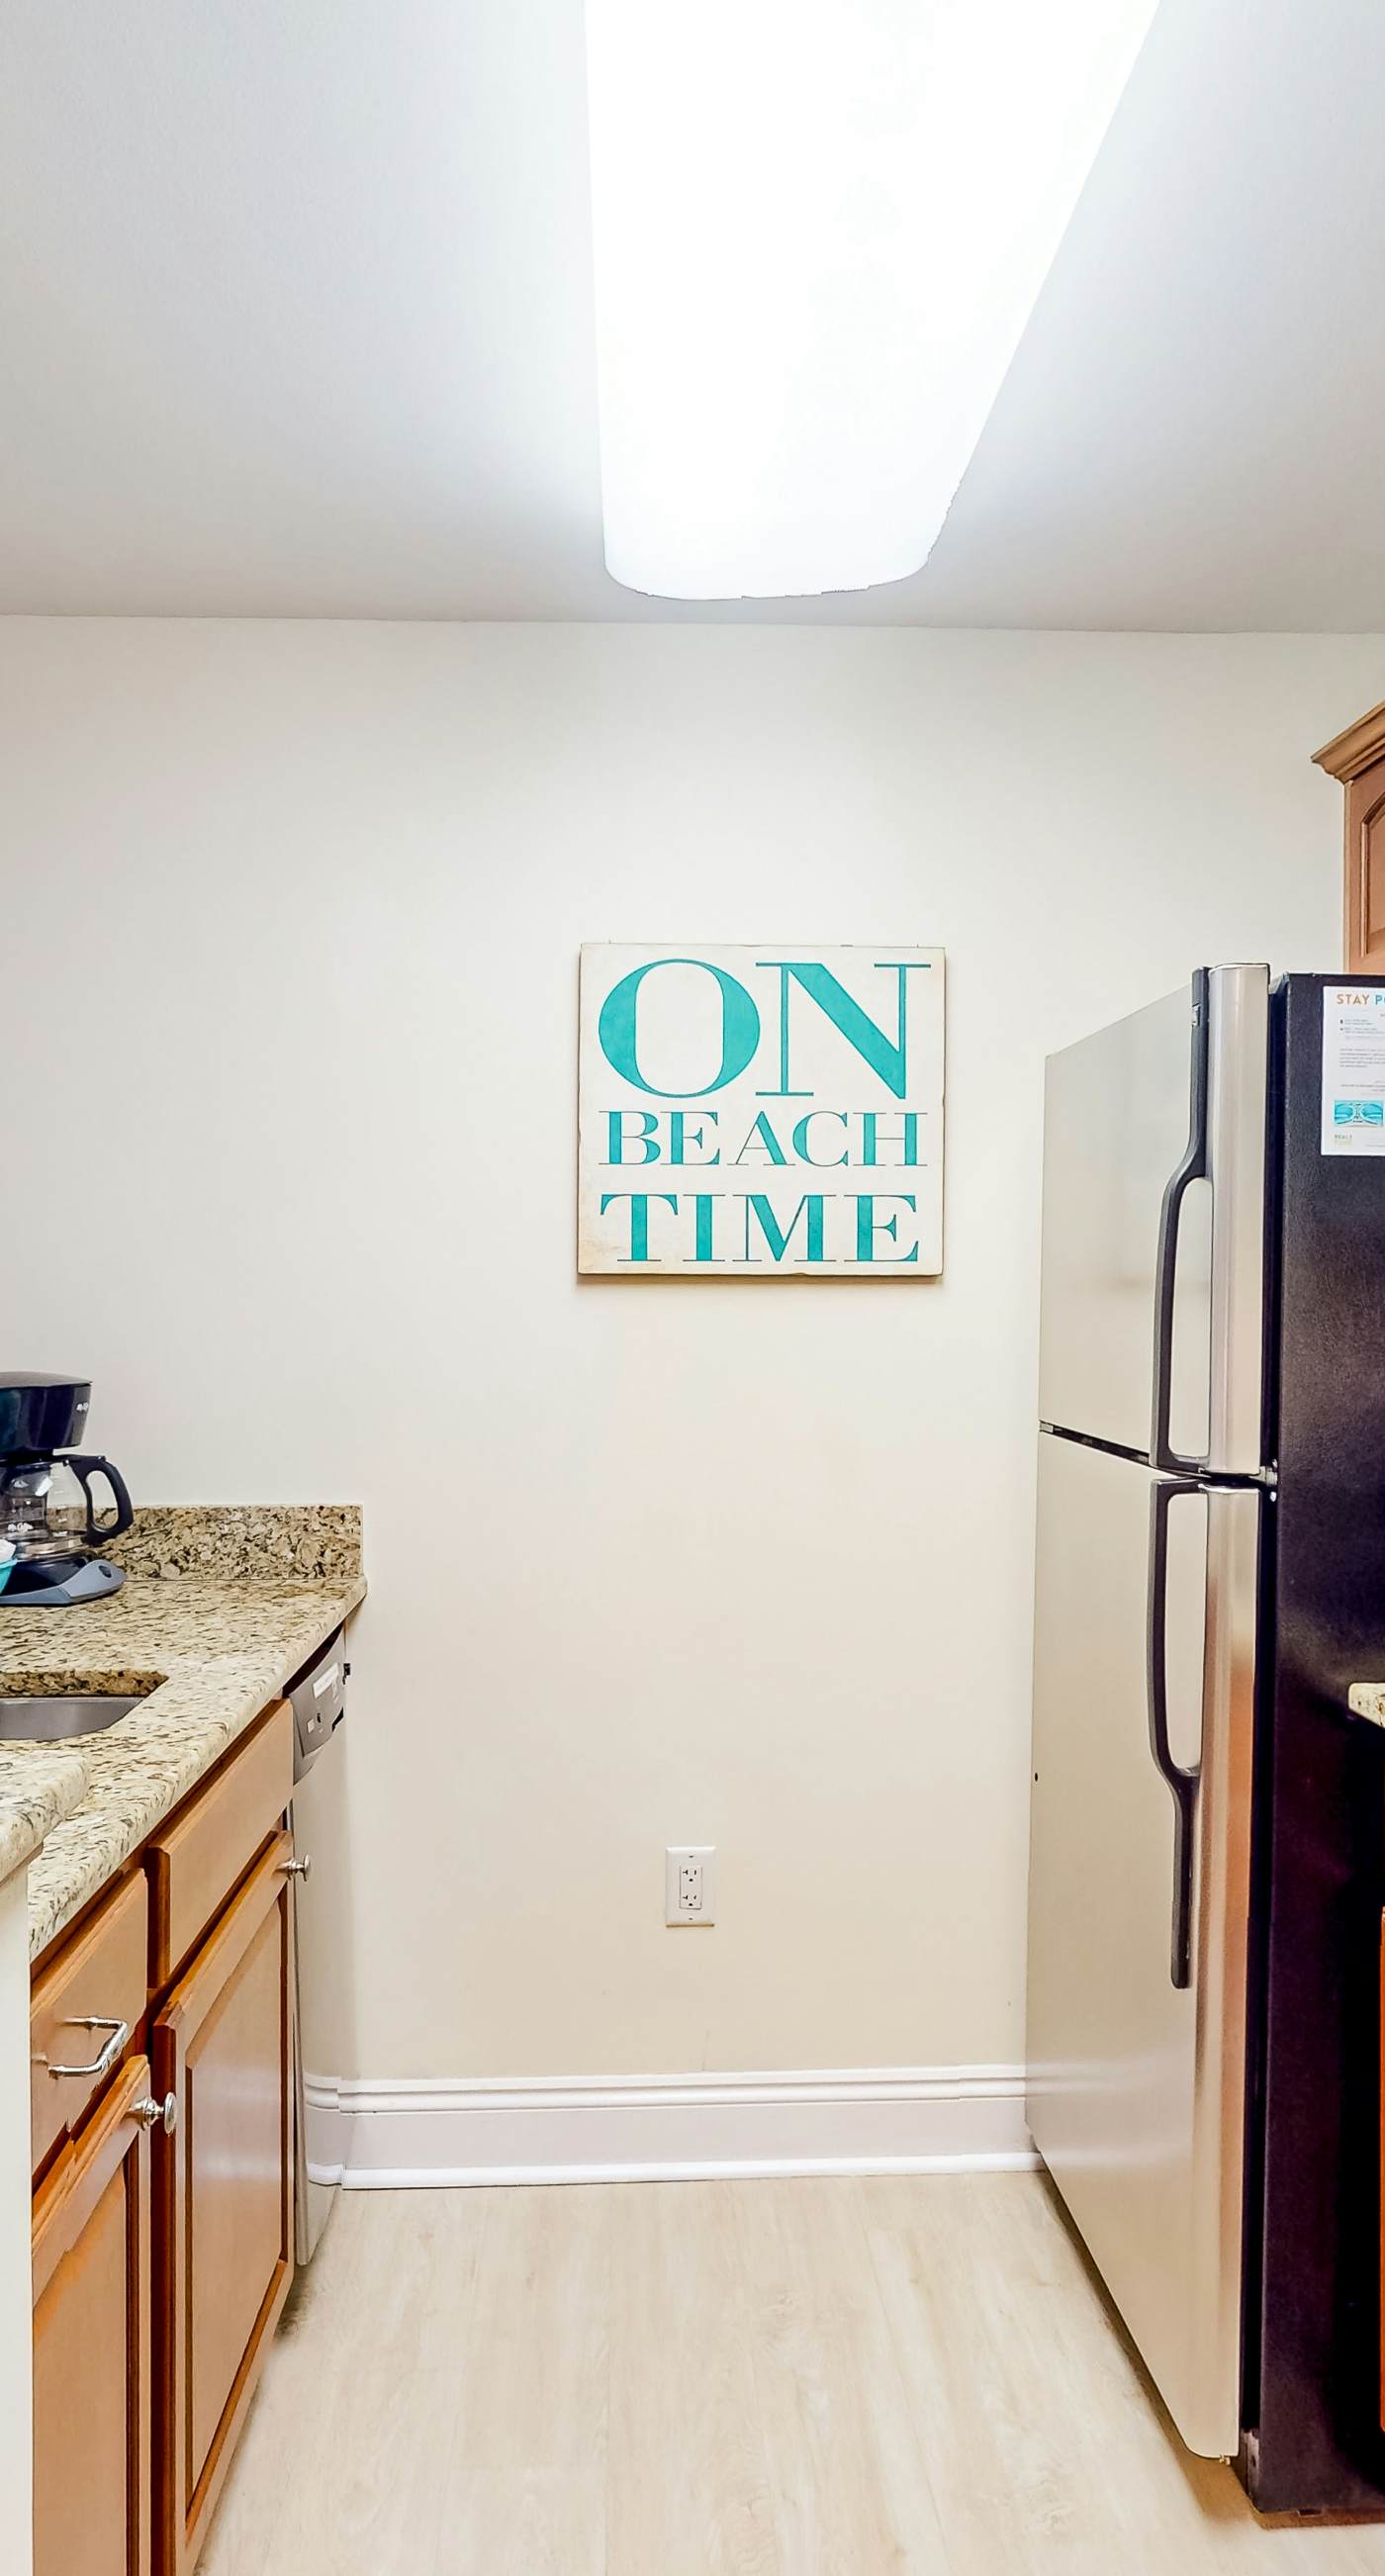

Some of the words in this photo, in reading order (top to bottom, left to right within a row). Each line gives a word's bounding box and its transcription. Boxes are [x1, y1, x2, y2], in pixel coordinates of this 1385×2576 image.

[599, 959, 931, 1100] ON
[1337, 993, 1370, 1005] STAY
[1375, 994, 1385, 1005] P
[599, 1111, 928, 1167] BEACH
[600, 1194, 919, 1262] TIME
